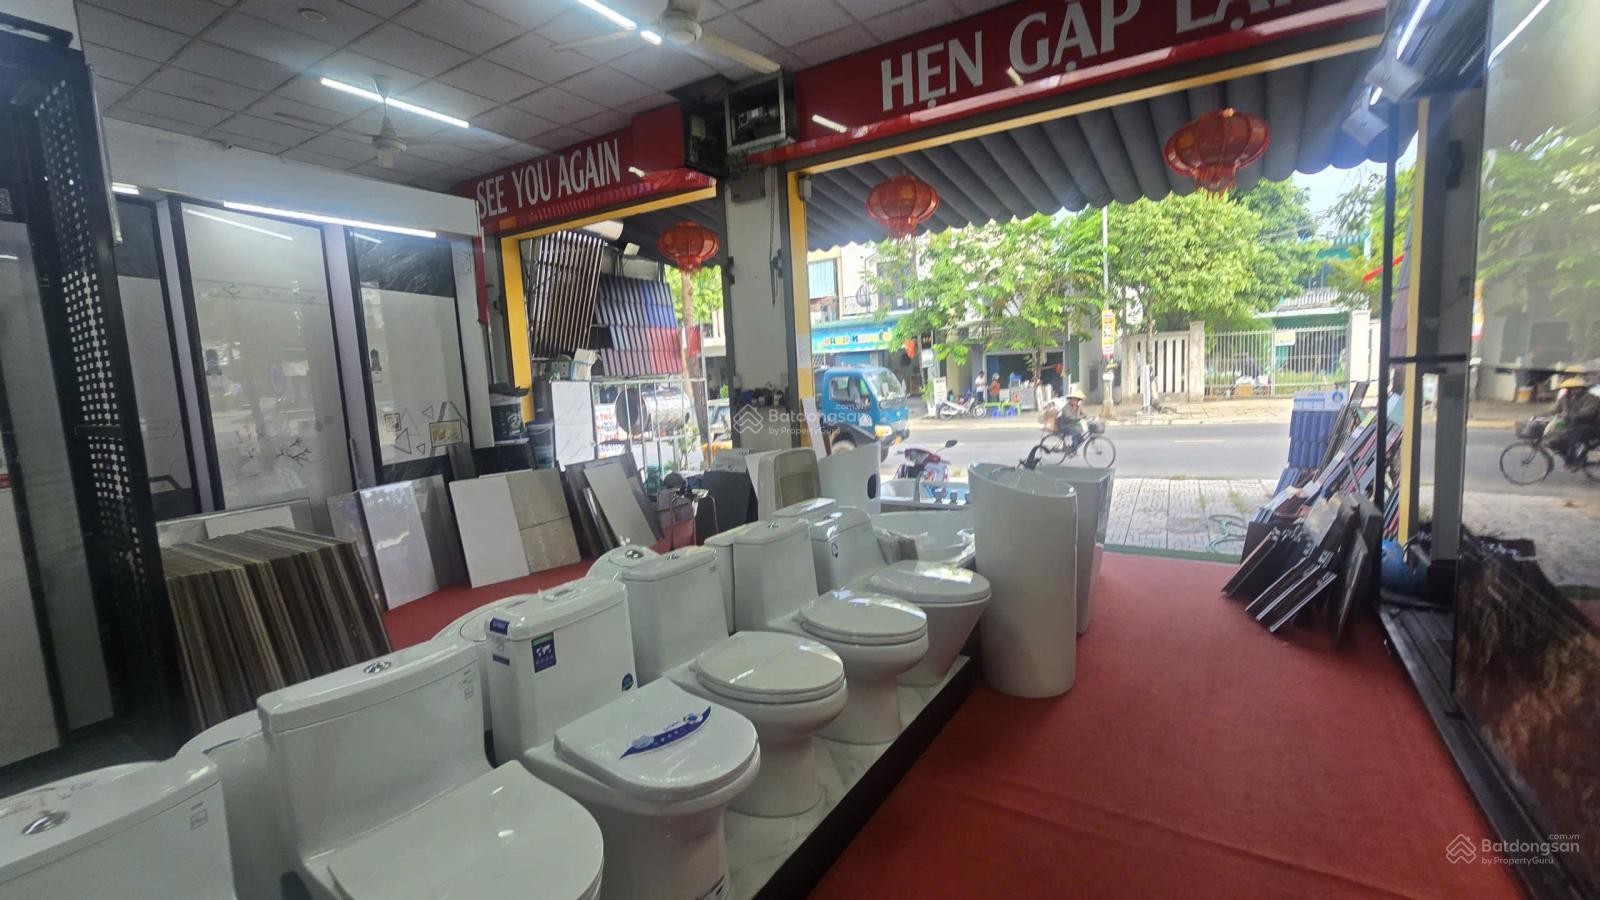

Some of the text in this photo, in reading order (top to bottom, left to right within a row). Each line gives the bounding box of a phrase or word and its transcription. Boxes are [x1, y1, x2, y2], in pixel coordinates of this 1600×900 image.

[880, 31, 984, 111] HẸN
[476, 138, 621, 219] SEE YOU AGAIN
